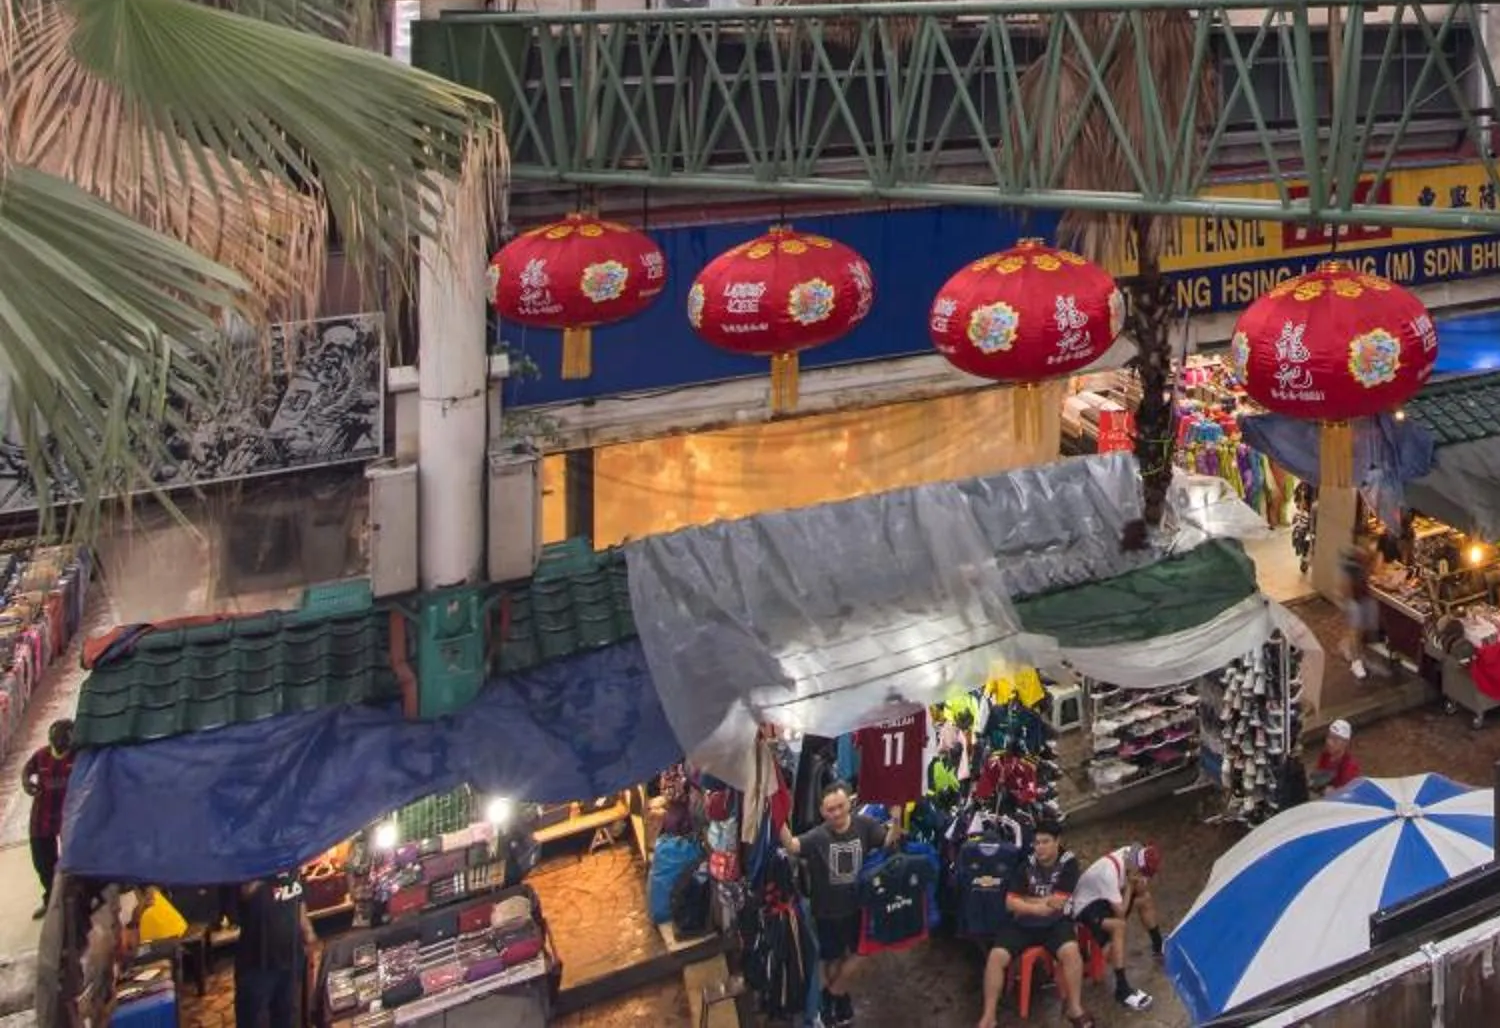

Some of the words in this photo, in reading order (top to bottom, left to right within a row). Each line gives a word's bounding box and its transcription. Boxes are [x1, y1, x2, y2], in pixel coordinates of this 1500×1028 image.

[1385, 251, 1415, 283] (M)
[1423, 246, 1464, 276] SDN
[881, 730, 906, 768] 11
